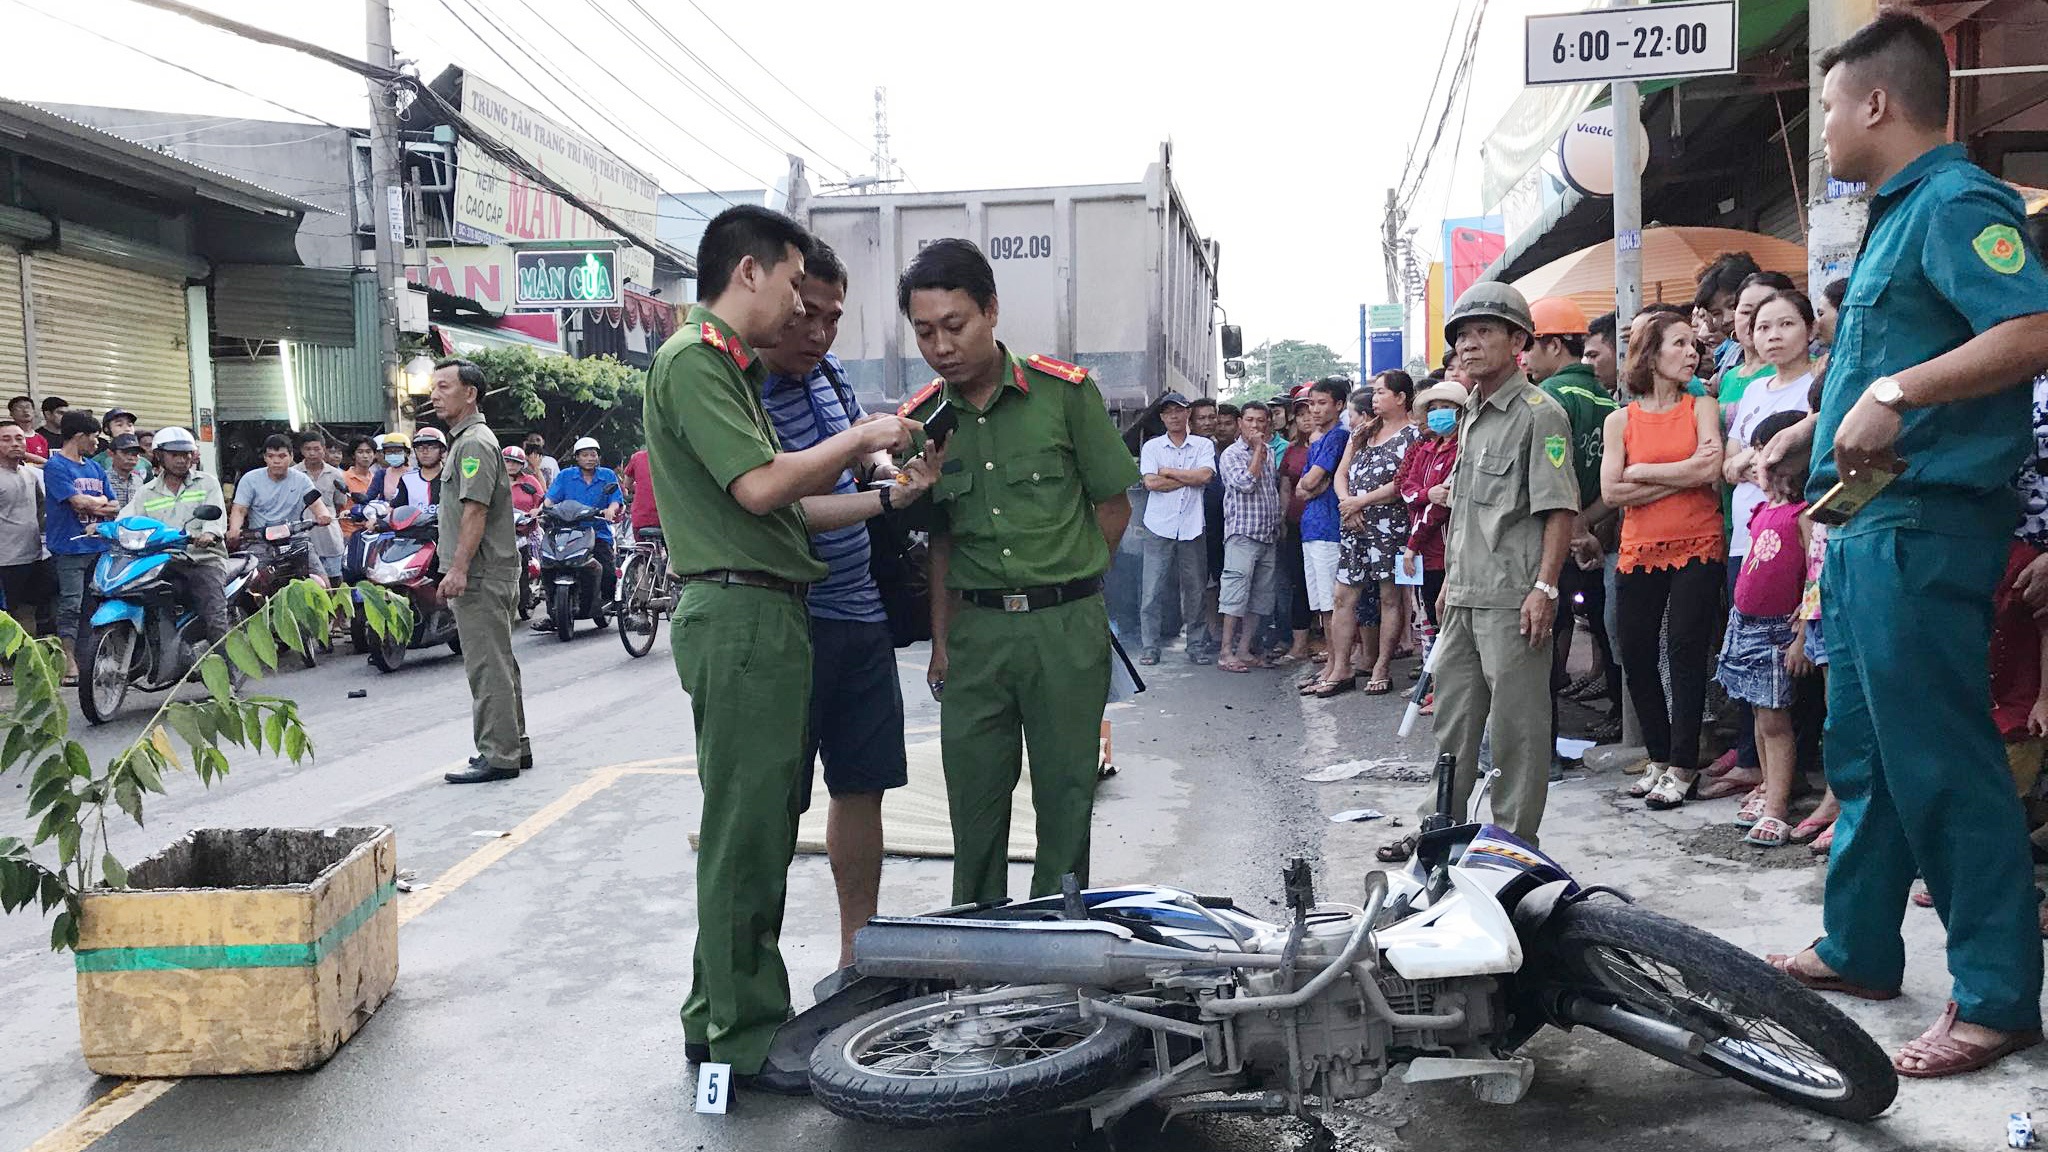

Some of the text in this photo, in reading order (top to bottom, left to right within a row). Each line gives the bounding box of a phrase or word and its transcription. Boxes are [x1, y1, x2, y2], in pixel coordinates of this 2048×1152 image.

[472, 90, 508, 126] TRUNG
[511, 110, 531, 139] TÂM
[534, 124, 565, 155] TRANG
[466, 195, 484, 218] CAO
[991, 235, 1051, 260] 092.09
[519, 258, 565, 300] MÀN
[568, 253, 613, 300] CỬA
[707, 1073, 719, 1105] 5
